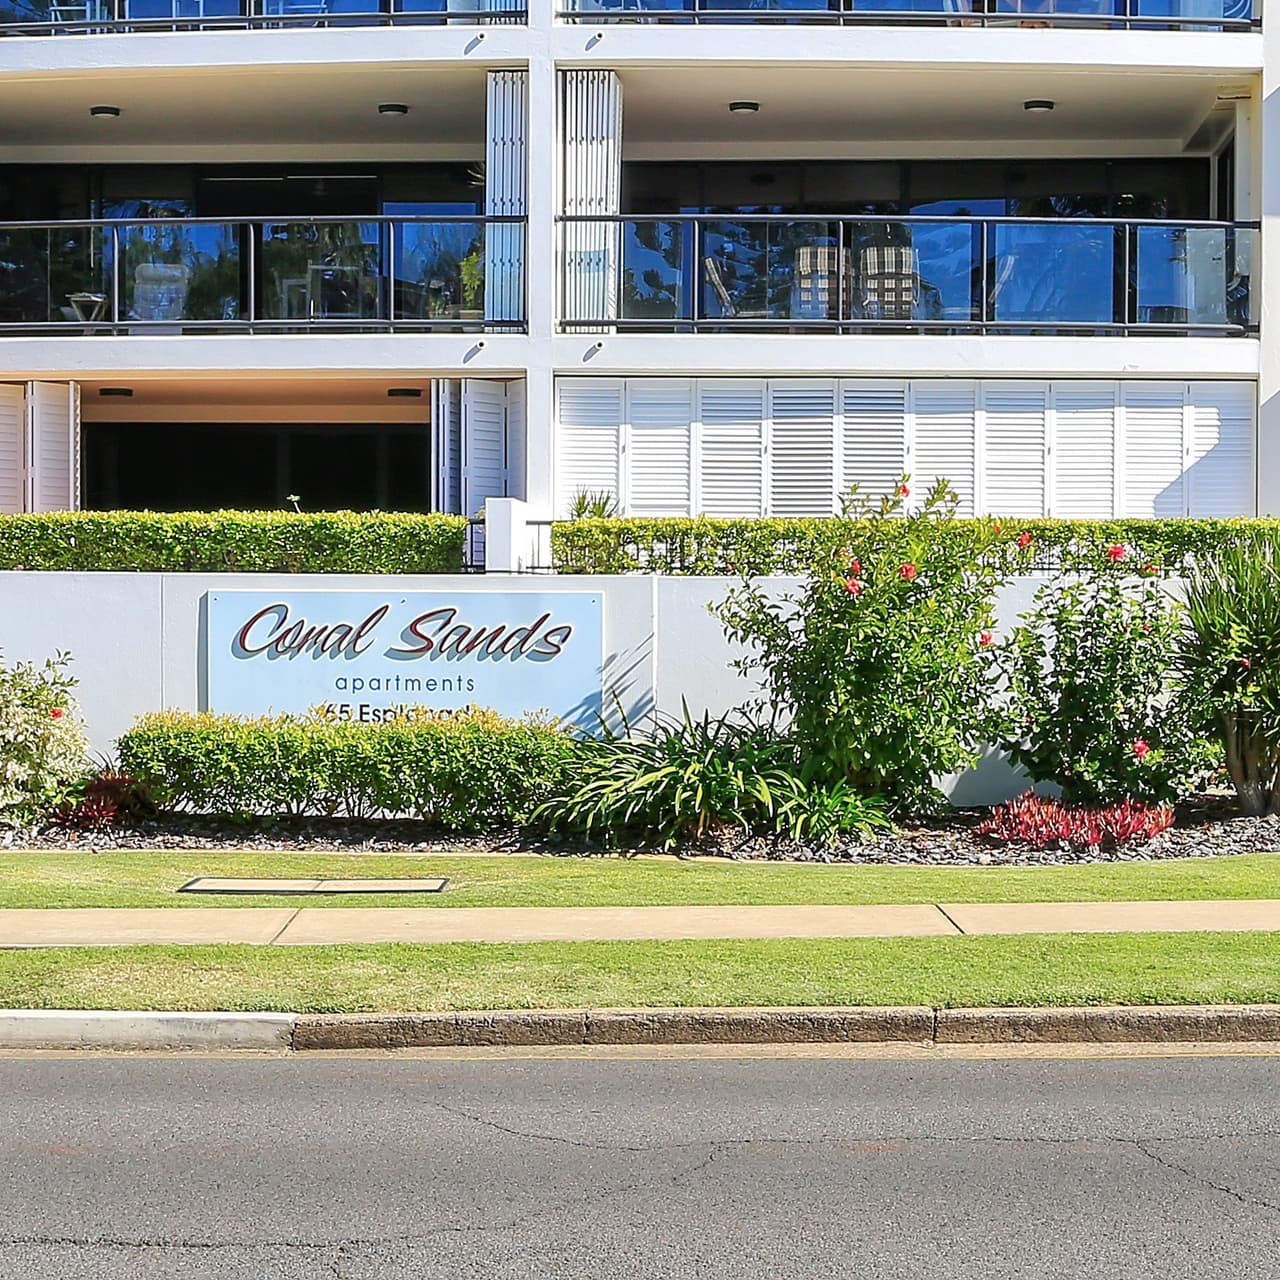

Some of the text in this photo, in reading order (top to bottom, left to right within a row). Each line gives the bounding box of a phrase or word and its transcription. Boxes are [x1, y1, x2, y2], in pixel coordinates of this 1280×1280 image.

[233, 604, 573, 658] Coral Sands
[335, 674, 475, 693] apartments
[325, 704, 351, 722] 65
